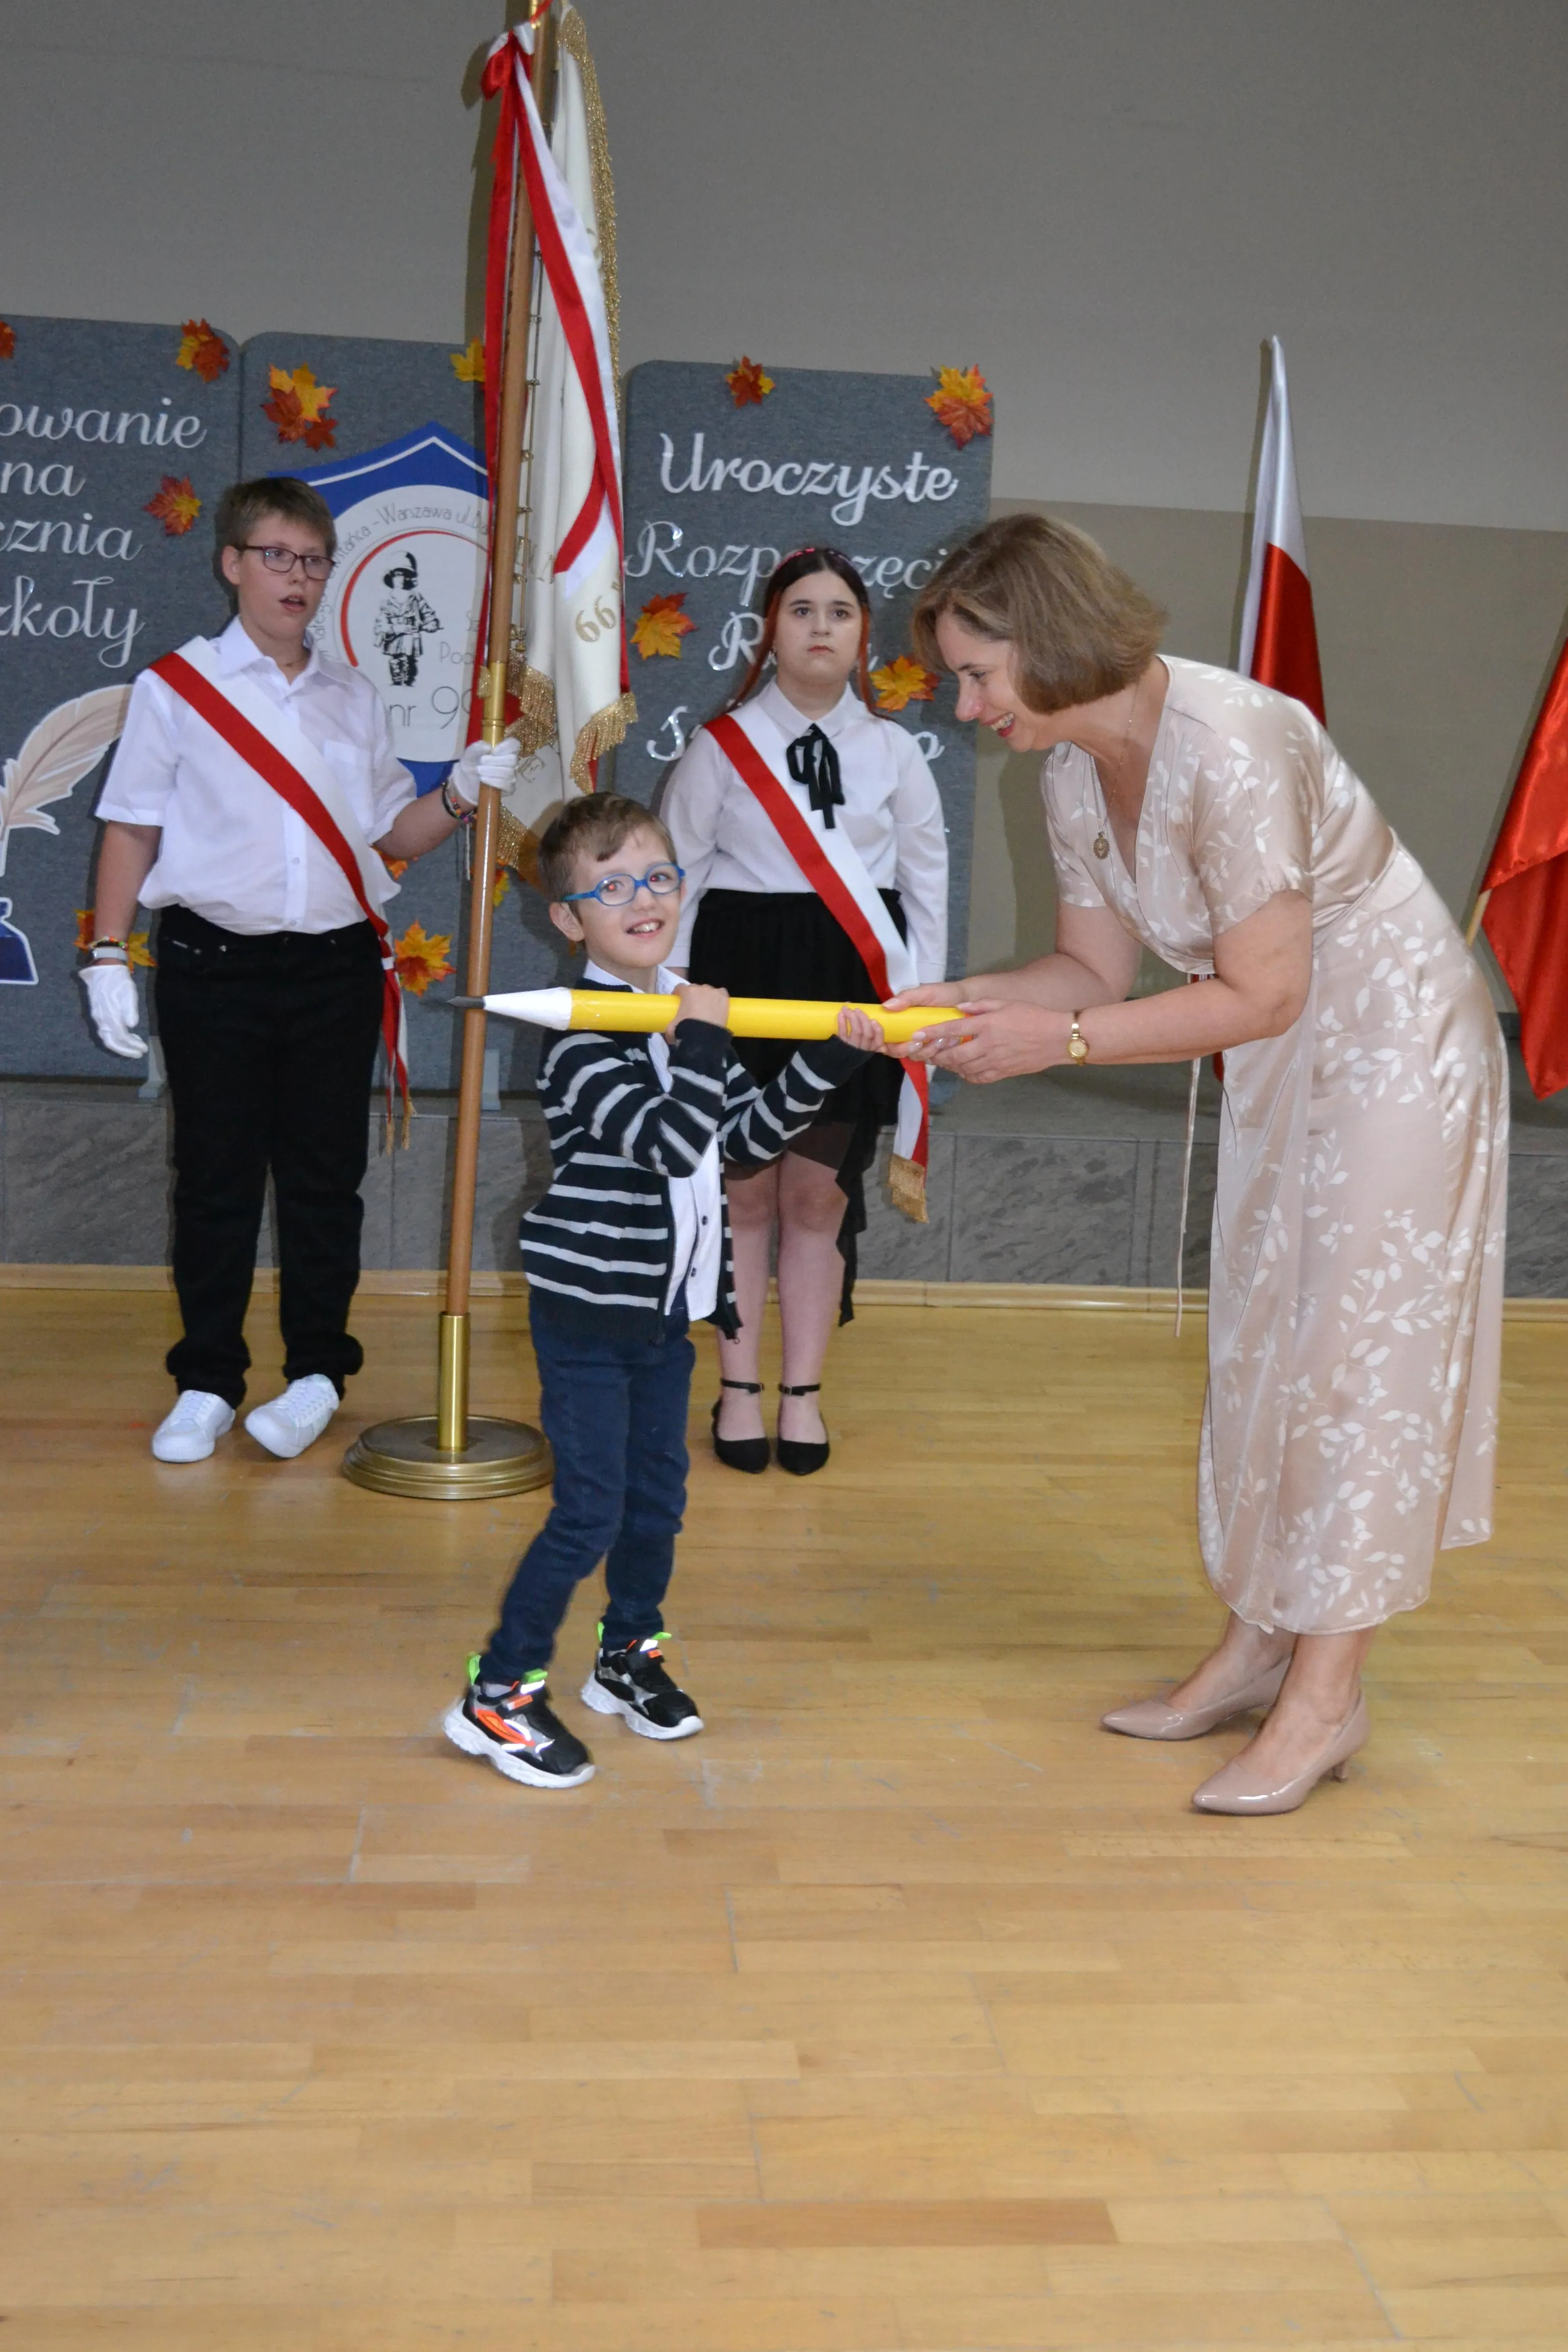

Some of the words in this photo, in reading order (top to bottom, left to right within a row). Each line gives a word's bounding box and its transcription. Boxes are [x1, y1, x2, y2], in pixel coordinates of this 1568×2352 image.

[0, 462, 86, 497] na
[660, 432, 959, 526] Uroczyste
[376, 502, 452, 526] Warszawa
[0, 512, 143, 561] znia
[389, 704, 417, 727] nr
